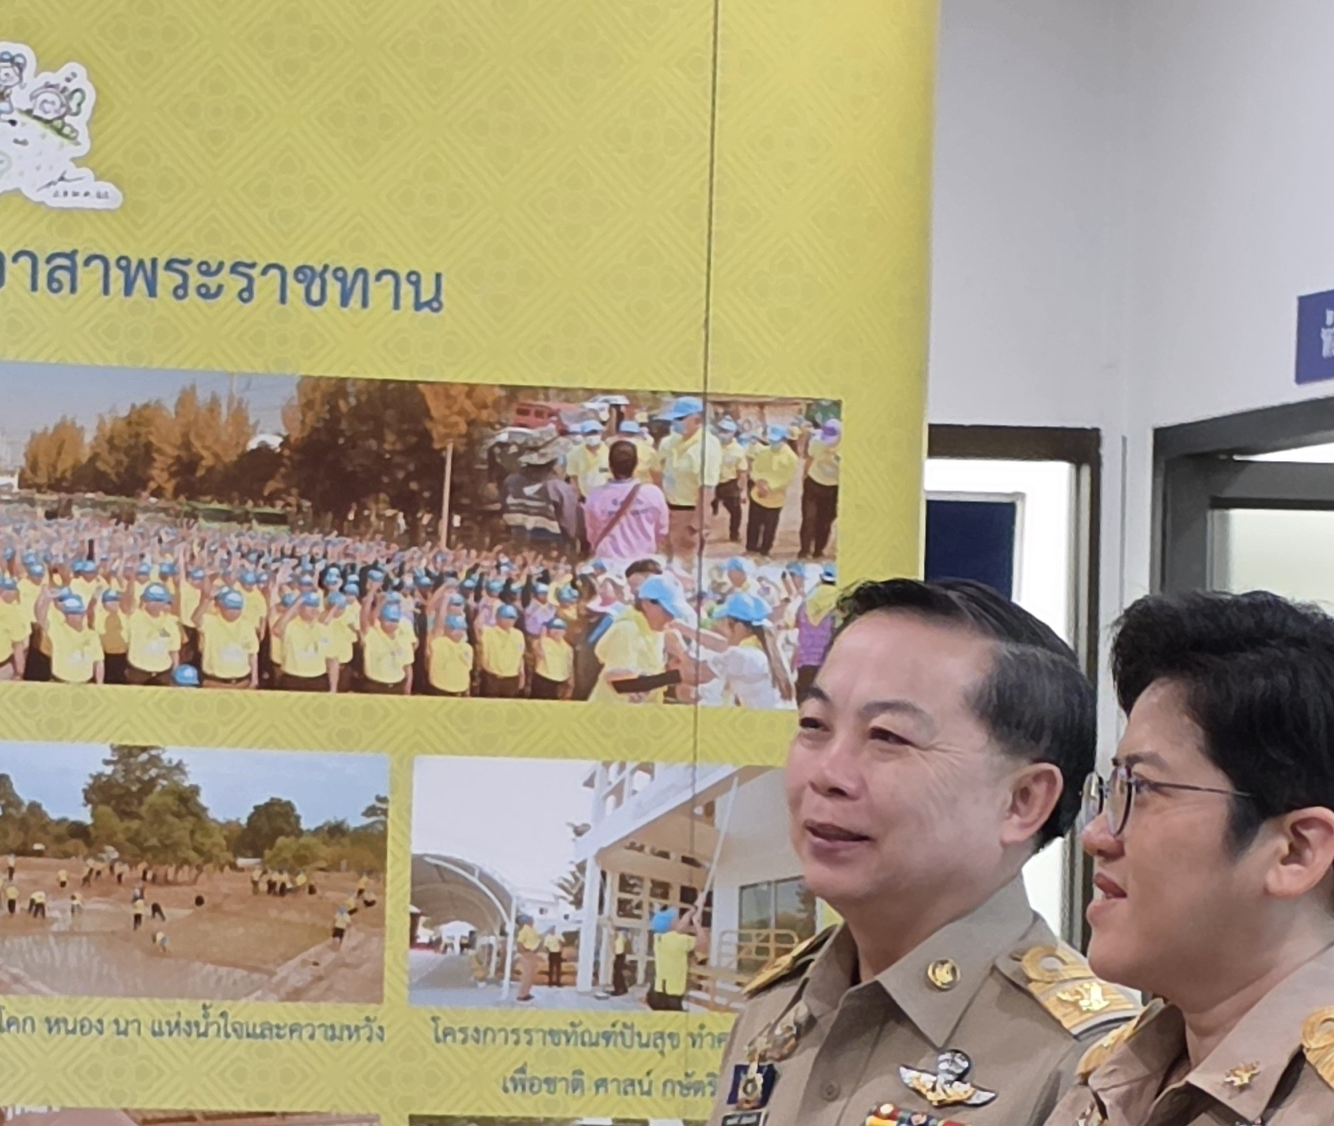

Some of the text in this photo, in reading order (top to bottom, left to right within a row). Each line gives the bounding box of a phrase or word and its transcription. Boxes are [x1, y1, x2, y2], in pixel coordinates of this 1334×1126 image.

[46, 1016, 104, 1037] หนอง
[114, 1018, 142, 1037] นา
[500, 1061, 586, 1096] เพื่อชาติ
